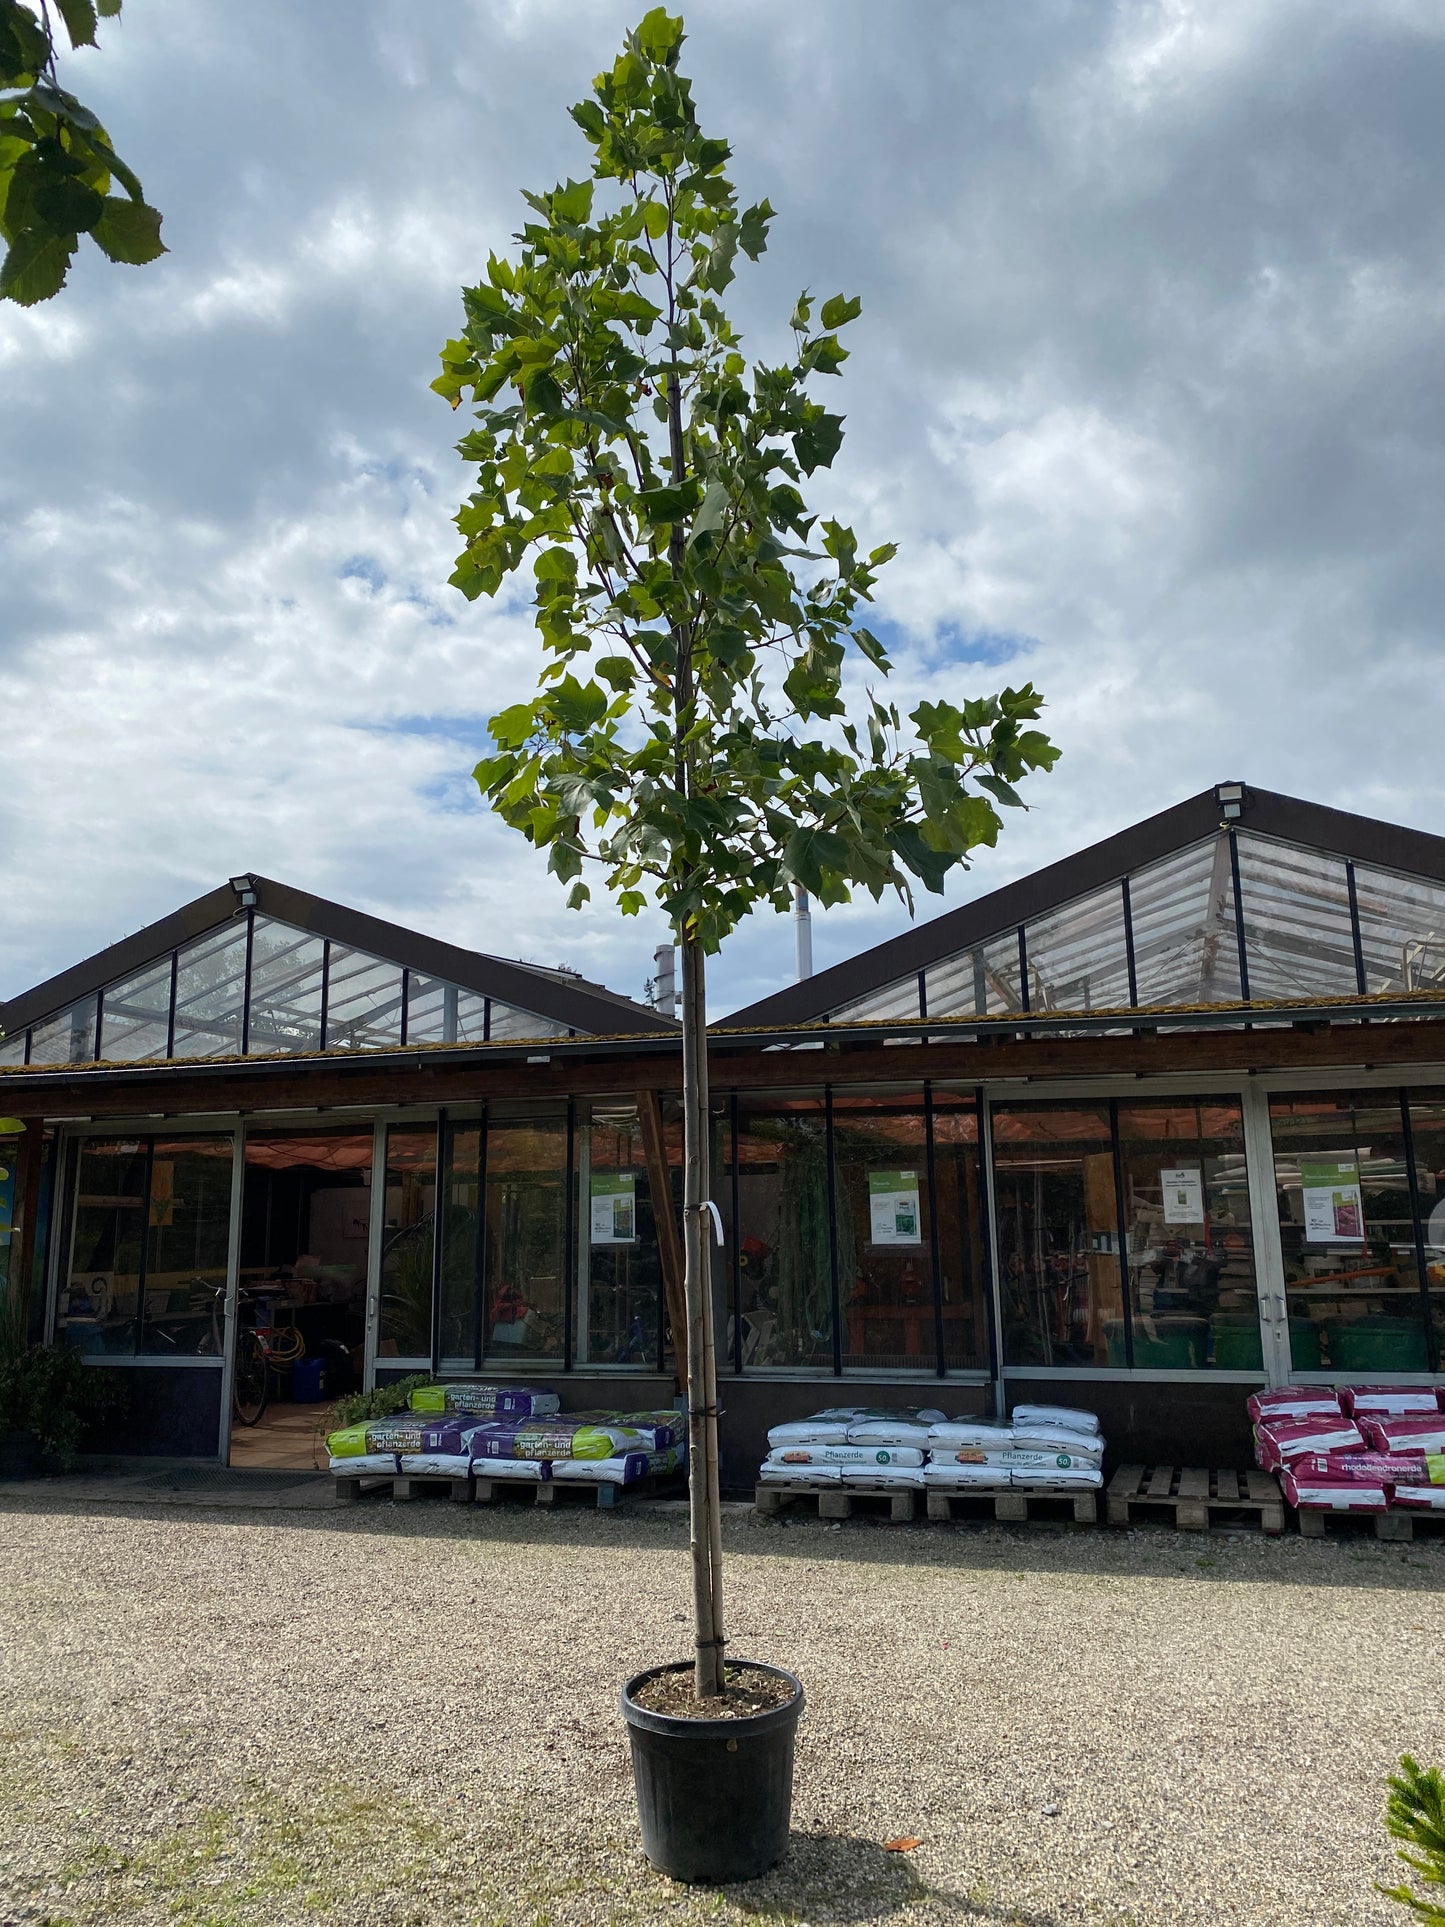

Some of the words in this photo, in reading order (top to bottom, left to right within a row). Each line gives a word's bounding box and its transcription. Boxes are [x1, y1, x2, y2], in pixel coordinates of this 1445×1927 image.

[450, 1393, 479, 1402] garten-
[454, 1401, 496, 1409] pflanzerde
[372, 1433, 403, 1441] garten-
[405, 1432, 421, 1440] und
[376, 1440, 421, 1448] pflanzerde
[520, 1441, 552, 1450] garten-
[525, 1449, 571, 1457] pflanzerde
[1002, 1452, 1043, 1460] Pflanzerde
[1341, 1464, 1422, 1472] rhododendronerde
